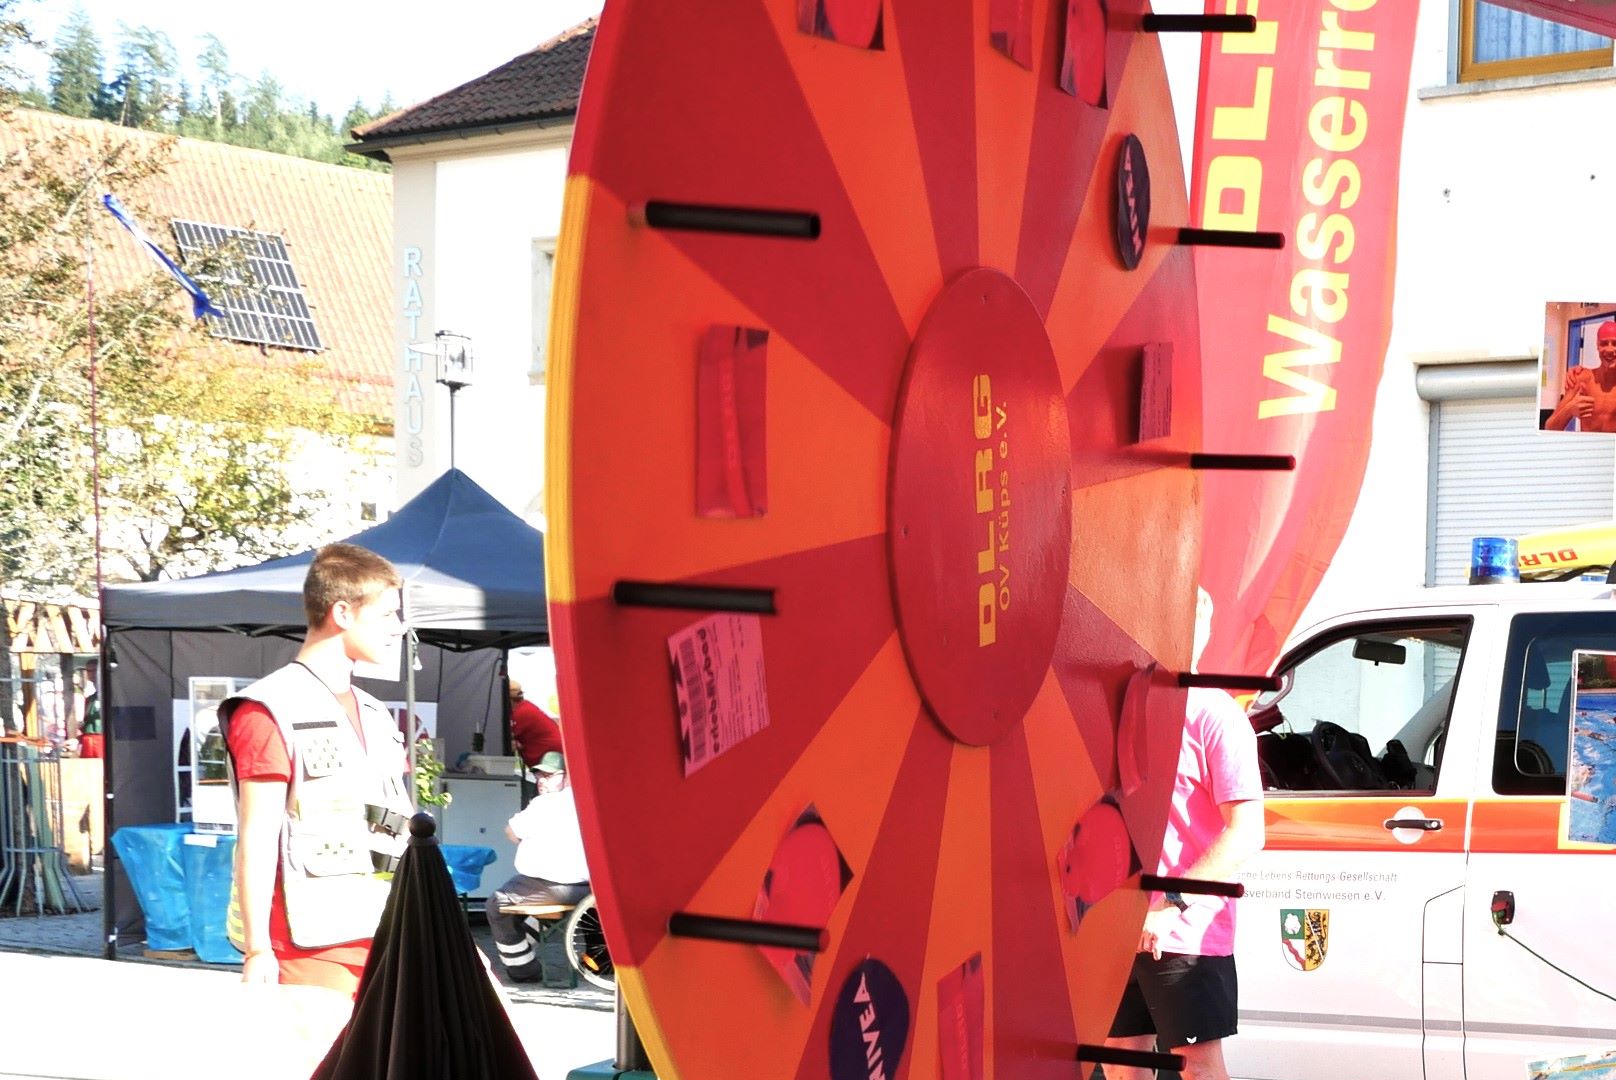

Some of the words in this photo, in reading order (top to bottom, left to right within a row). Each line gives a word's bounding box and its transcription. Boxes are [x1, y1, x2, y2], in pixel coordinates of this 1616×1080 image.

[1257, 0, 1378, 419] Wasserr
[403, 246, 424, 468] RATHAUS
[995, 400, 1009, 460] e.V.
[973, 374, 997, 648] DLRG
[997, 470, 1011, 552] Küps
[998, 563, 1011, 611] OV
[1518, 548, 1579, 568] DLR
[1295, 888, 1360, 901] Steinwiesen
